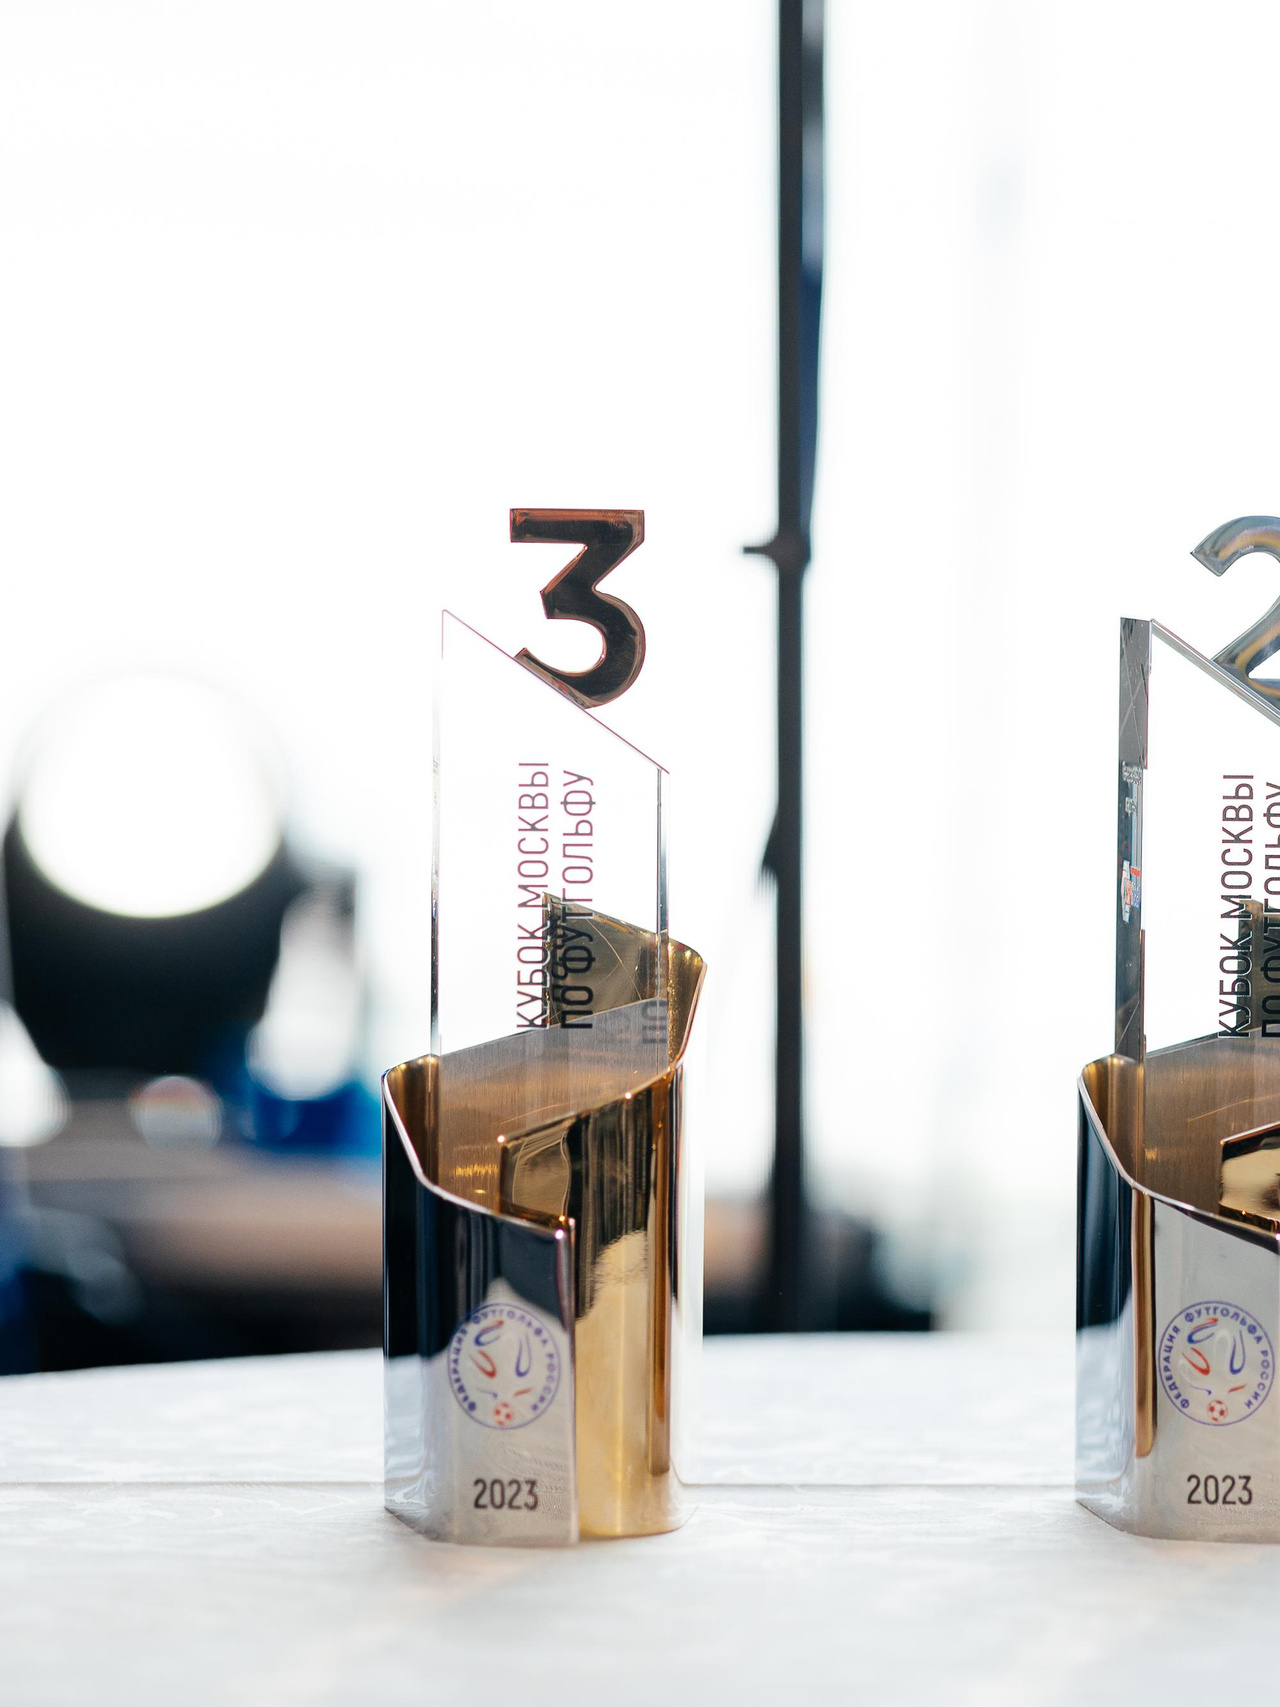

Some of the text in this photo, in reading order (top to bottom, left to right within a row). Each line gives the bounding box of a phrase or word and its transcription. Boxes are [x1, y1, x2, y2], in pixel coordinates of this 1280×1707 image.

[509, 508, 646, 710] 3
[516, 762, 550, 1029] КУБОК МОСКВЫ
[558, 769, 596, 1029] ПО ФУТГОЛЬФУ
[1218, 774, 1254, 1038] КУБОК МОСКВЫ
[1163, 1305, 1271, 1410] ФЕДЕРАЦИЯ ФУТГОЛЬФА РОССИИ
[473, 1478, 539, 1511] 2023
[1186, 1474, 1253, 1506] 2023
